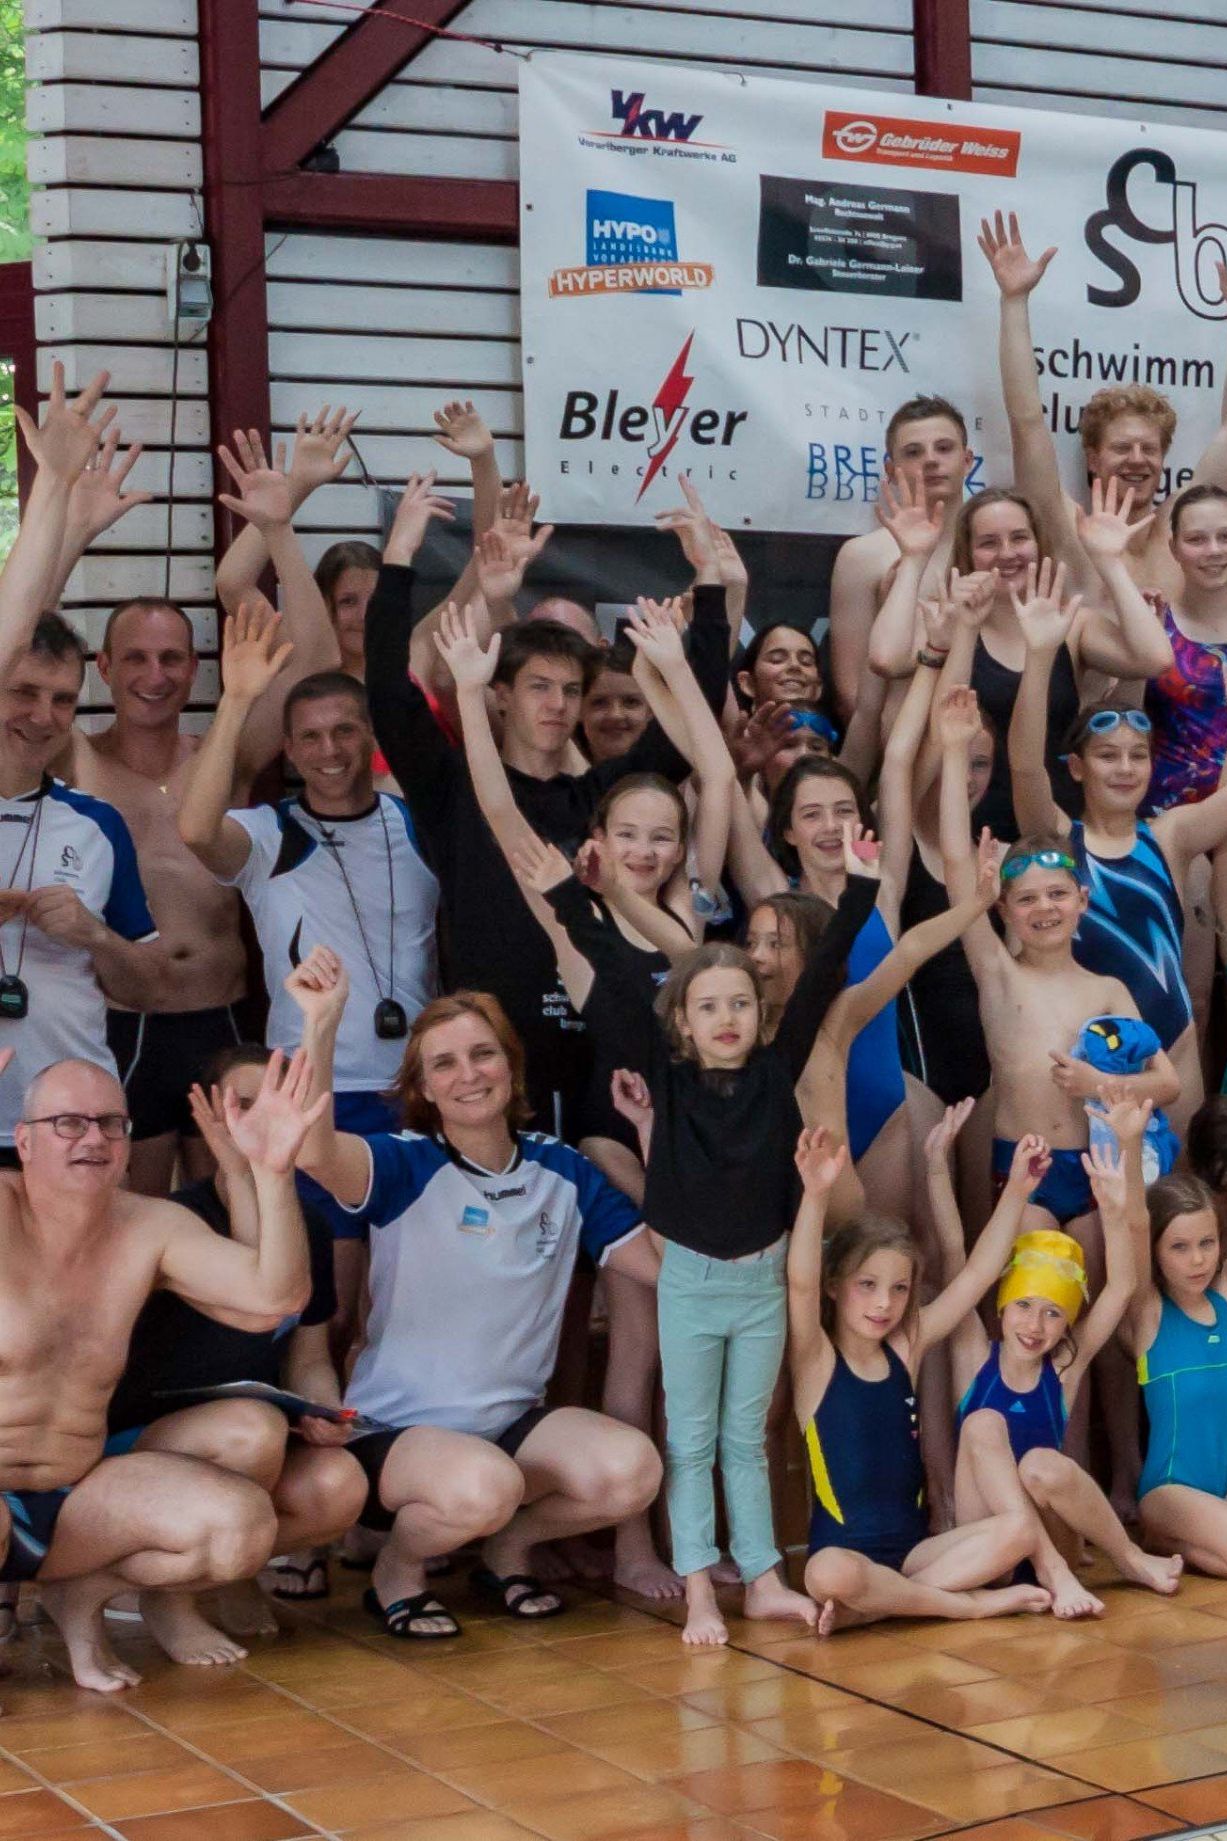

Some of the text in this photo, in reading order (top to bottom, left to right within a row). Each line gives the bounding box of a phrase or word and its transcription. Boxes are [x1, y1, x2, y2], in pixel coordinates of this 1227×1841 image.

[721, 153, 737, 163] AG
[879, 132, 1009, 159] Gebrüder Weiss
[592, 219, 658, 244] HYPO
[788, 254, 803, 266] Dr.
[555, 266, 707, 293] HYPERWORLD
[736, 318, 911, 374] DYNTEX
[1032, 338, 1214, 389] schwimm
[559, 389, 748, 459] Bleyer
[560, 460, 737, 481] Electric
